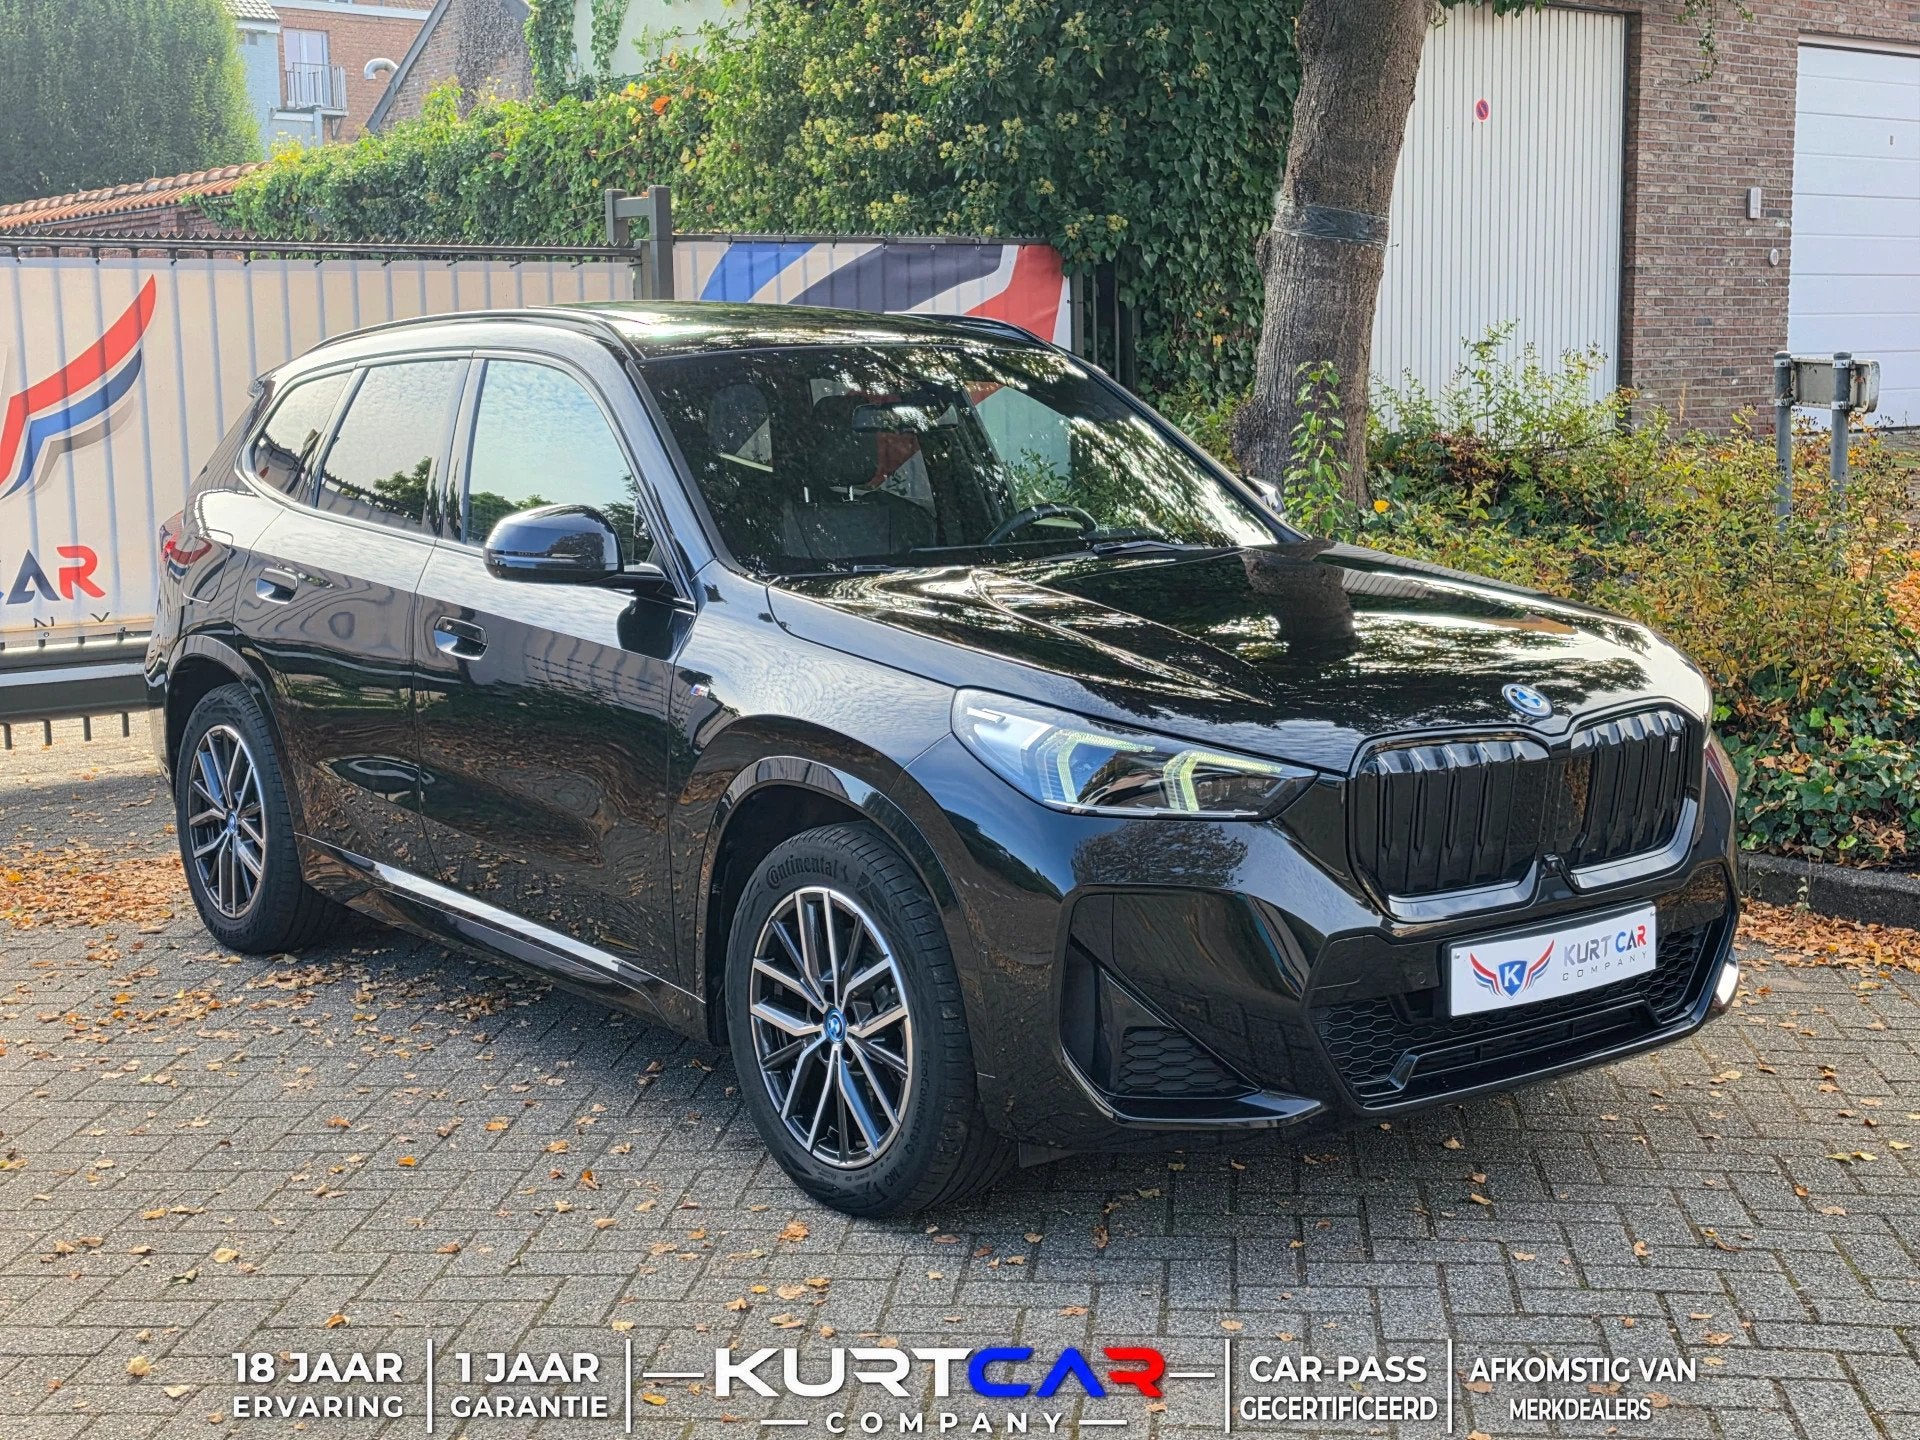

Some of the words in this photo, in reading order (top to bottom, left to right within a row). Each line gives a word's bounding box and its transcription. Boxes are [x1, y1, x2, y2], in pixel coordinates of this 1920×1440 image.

[0, 545, 106, 605] AR
[766, 854, 837, 889] Continental
[1563, 934, 1613, 968] KURT
[1615, 924, 1647, 954] CAR
[1503, 964, 1521, 987] K
[1562, 951, 1647, 981] COMPANY
